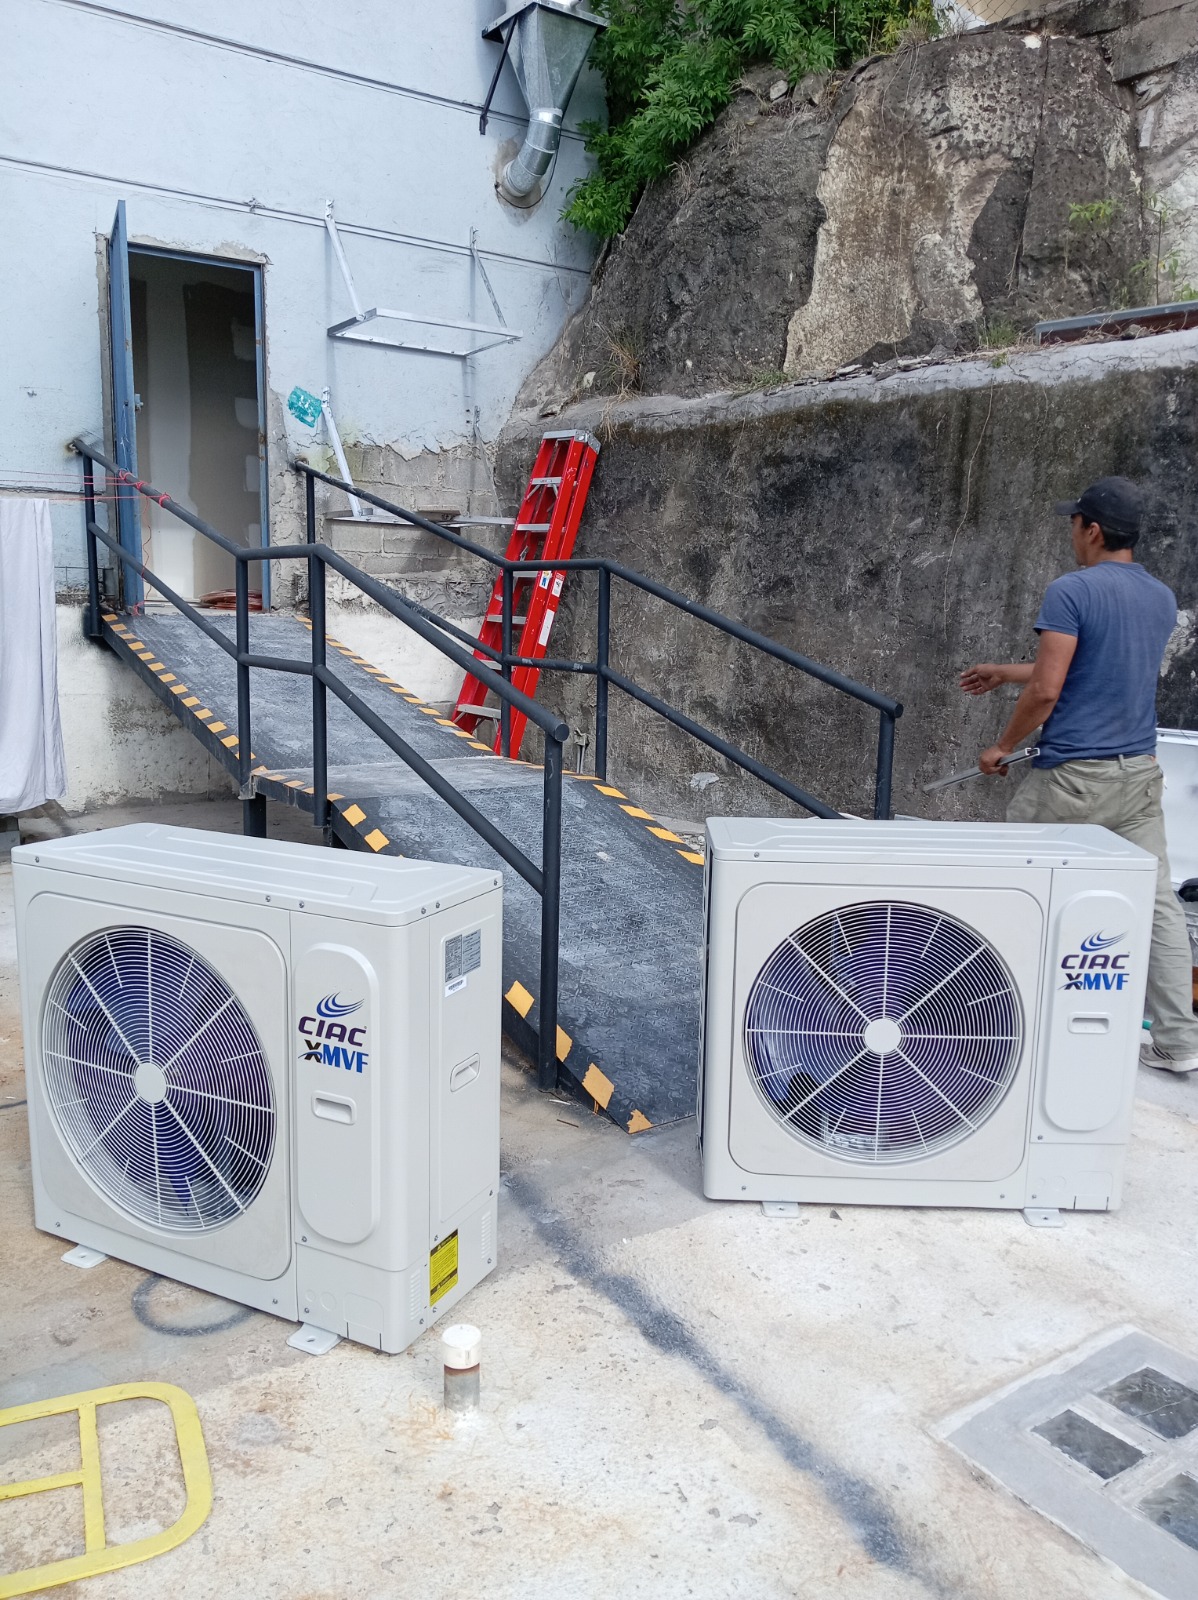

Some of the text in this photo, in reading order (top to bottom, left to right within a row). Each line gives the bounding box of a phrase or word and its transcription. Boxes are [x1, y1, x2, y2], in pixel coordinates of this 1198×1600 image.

[1061, 954, 1130, 969] CIAC
[1061, 973, 1130, 991] XMVF
[298, 1016, 366, 1047] CIAC
[300, 1039, 369, 1074] XMVF
